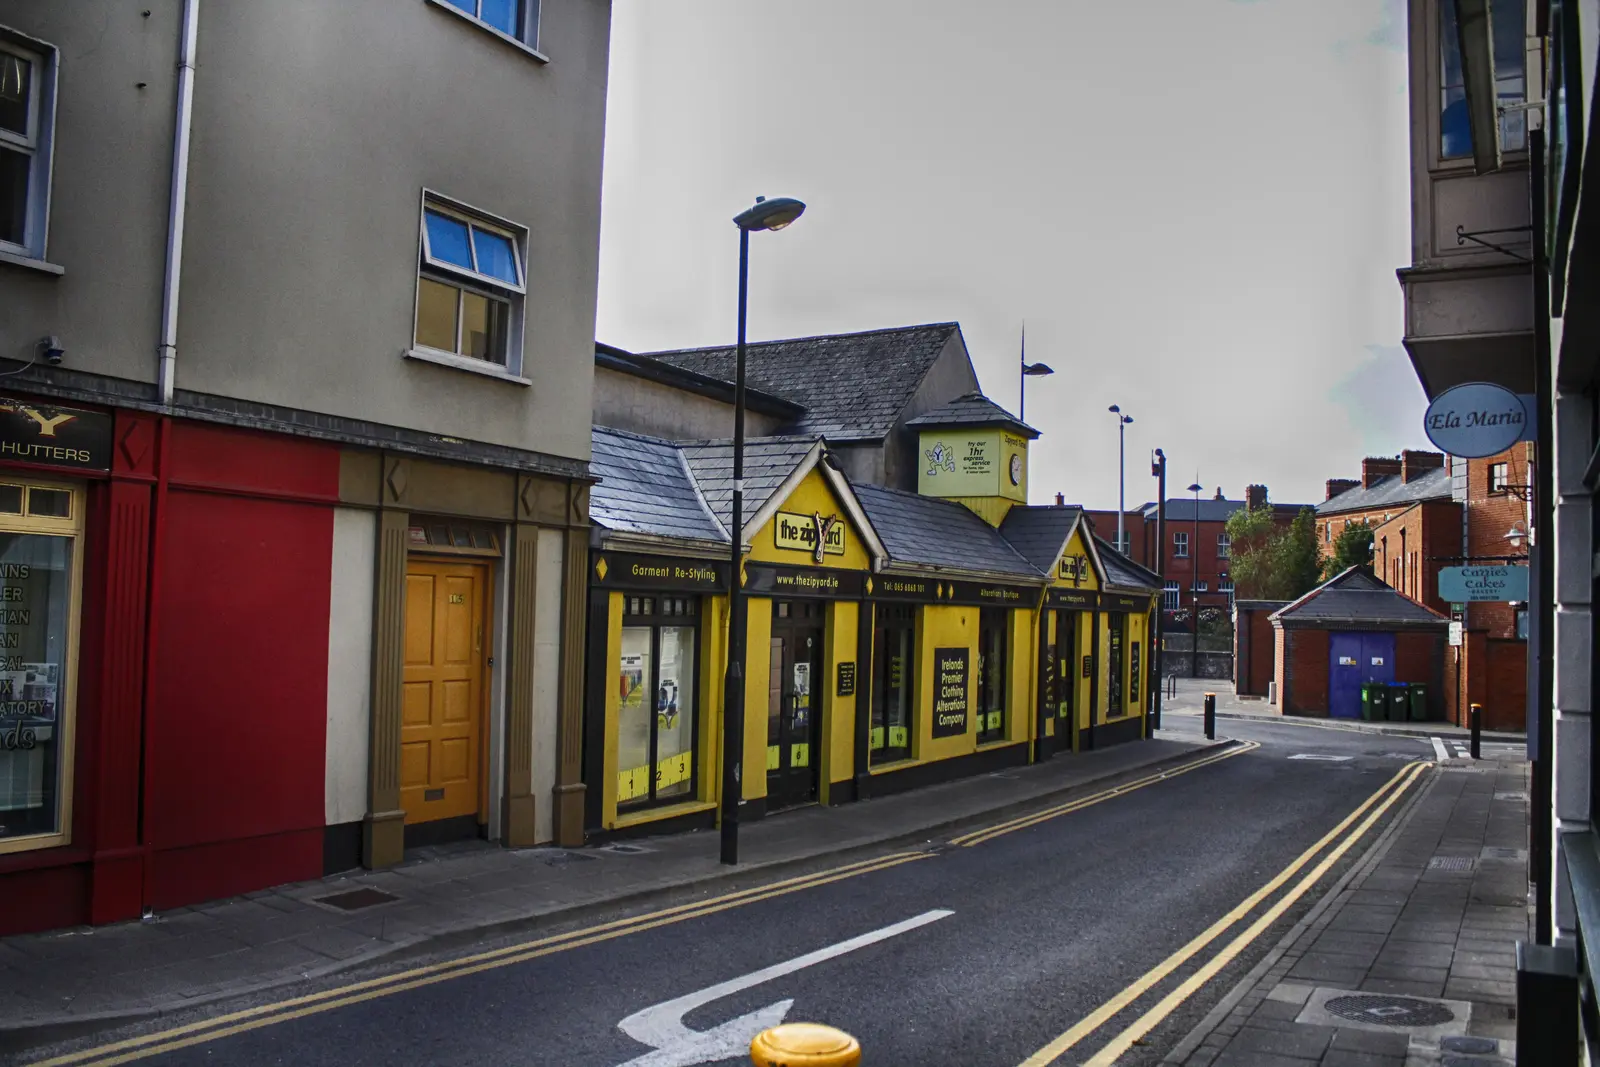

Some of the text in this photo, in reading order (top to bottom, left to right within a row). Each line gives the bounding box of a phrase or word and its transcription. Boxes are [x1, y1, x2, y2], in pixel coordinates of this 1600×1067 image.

[0, 405, 76, 436] Y
[1428, 408, 1522, 429] Ela Maria
[2, 441, 90, 462] HUTTERS
[969, 447, 984, 456] 1hr
[781, 519, 798, 540] the
[632, 564, 716, 582] Garment Re-Styling
[776, 574, 839, 588] www.thezipyard.ie
[1465, 576, 1506, 588] Cakes
[0, 587, 23, 601] ER
[941, 657, 964, 670] Irelands
[941, 671, 963, 684] Premier
[0, 680, 12, 694] X
[941, 685, 964, 699] Clothing
[0, 700, 46, 715] ATORY
[936, 698, 966, 713] Alterations
[938, 713, 965, 727] Company
[0, 719, 36, 750] ds
[679, 763, 685, 773] 3
[656, 771, 662, 781] 2
[629, 779, 633, 790] 1
